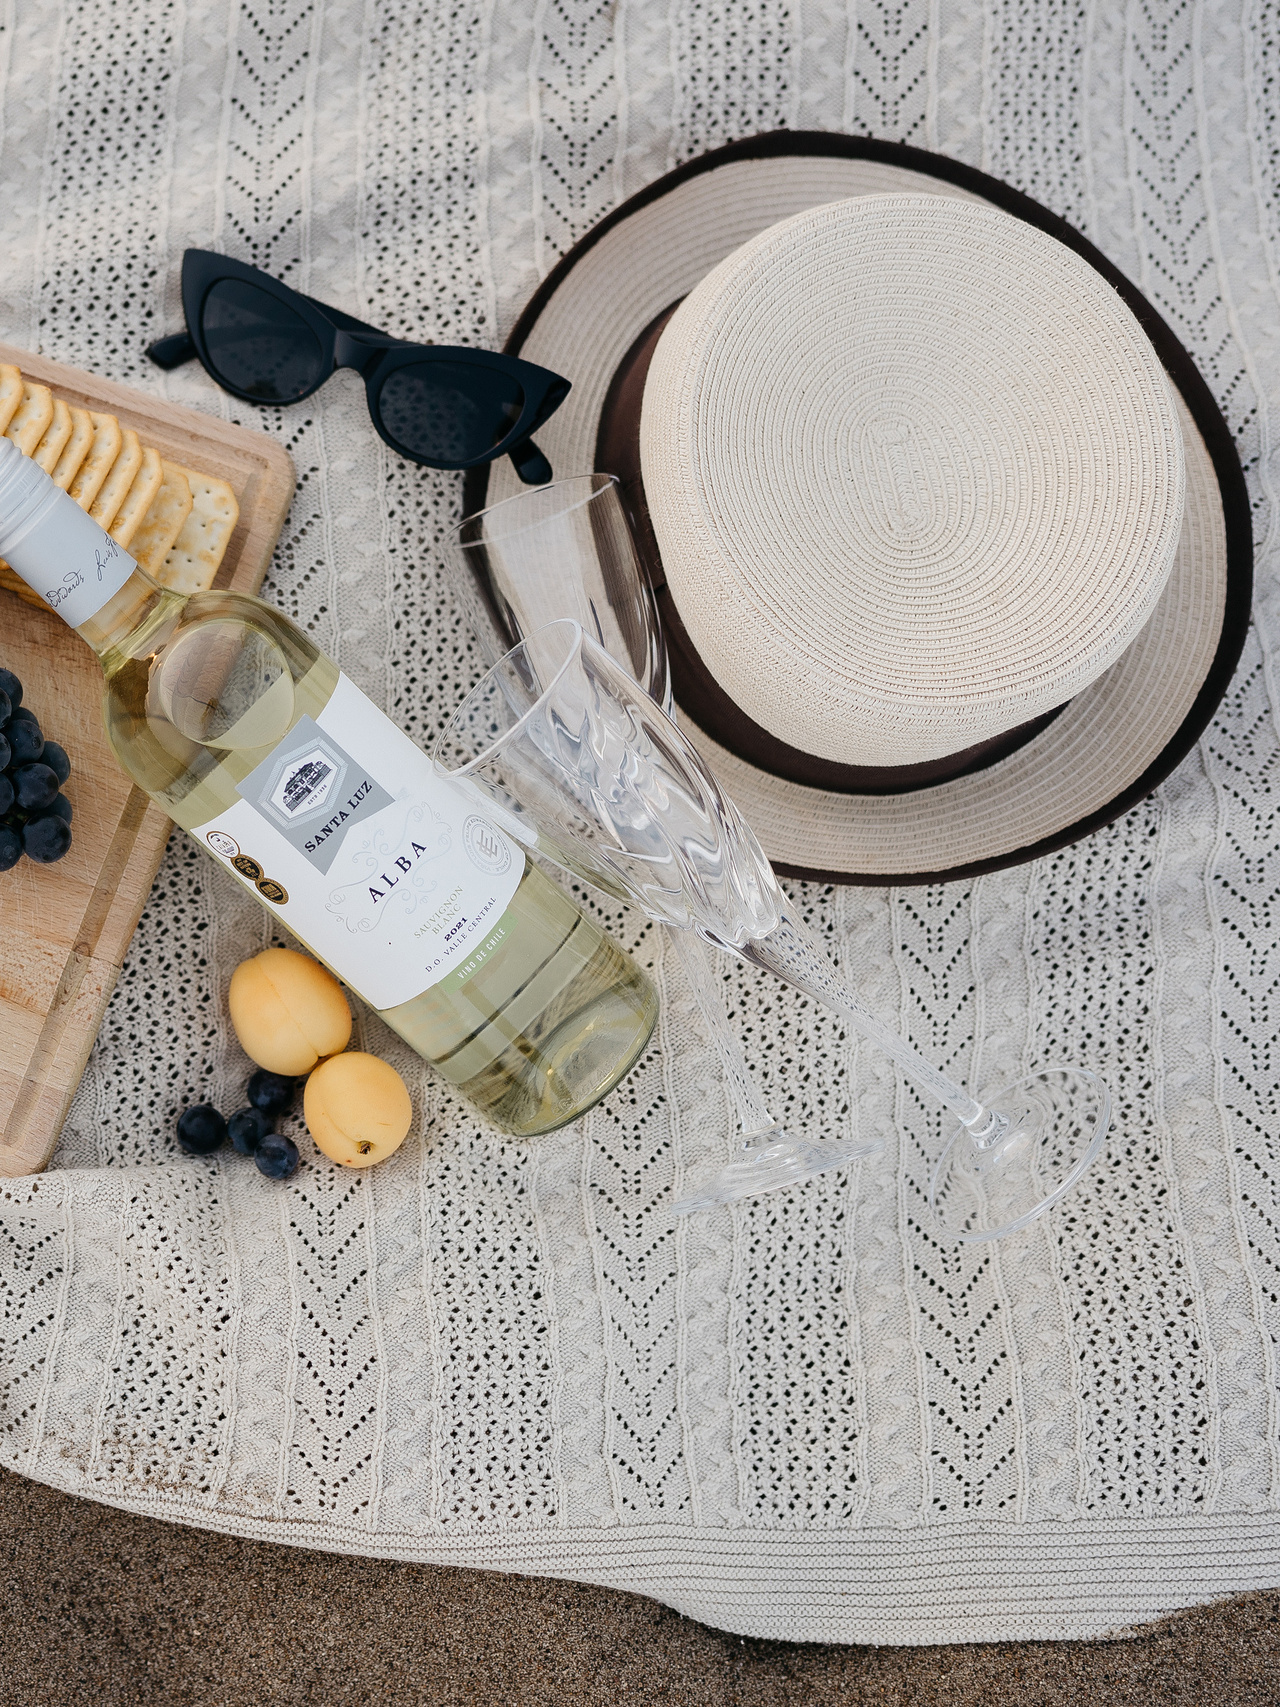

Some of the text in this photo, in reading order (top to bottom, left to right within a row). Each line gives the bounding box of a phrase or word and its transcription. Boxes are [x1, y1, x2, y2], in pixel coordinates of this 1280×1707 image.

[304, 780, 373, 853] SANTA LUZ
[368, 842, 427, 904] ALBA
[414, 885, 464, 939] SAUVIGNON
[425, 958, 444, 973] D.O.
[443, 932, 468, 956] VALLE
[467, 897, 497, 932] CENTRAL
[431, 903, 462, 935] BLANC
[444, 917, 468, 942] 2021
[457, 927, 506, 979] VINO DE CHILE
